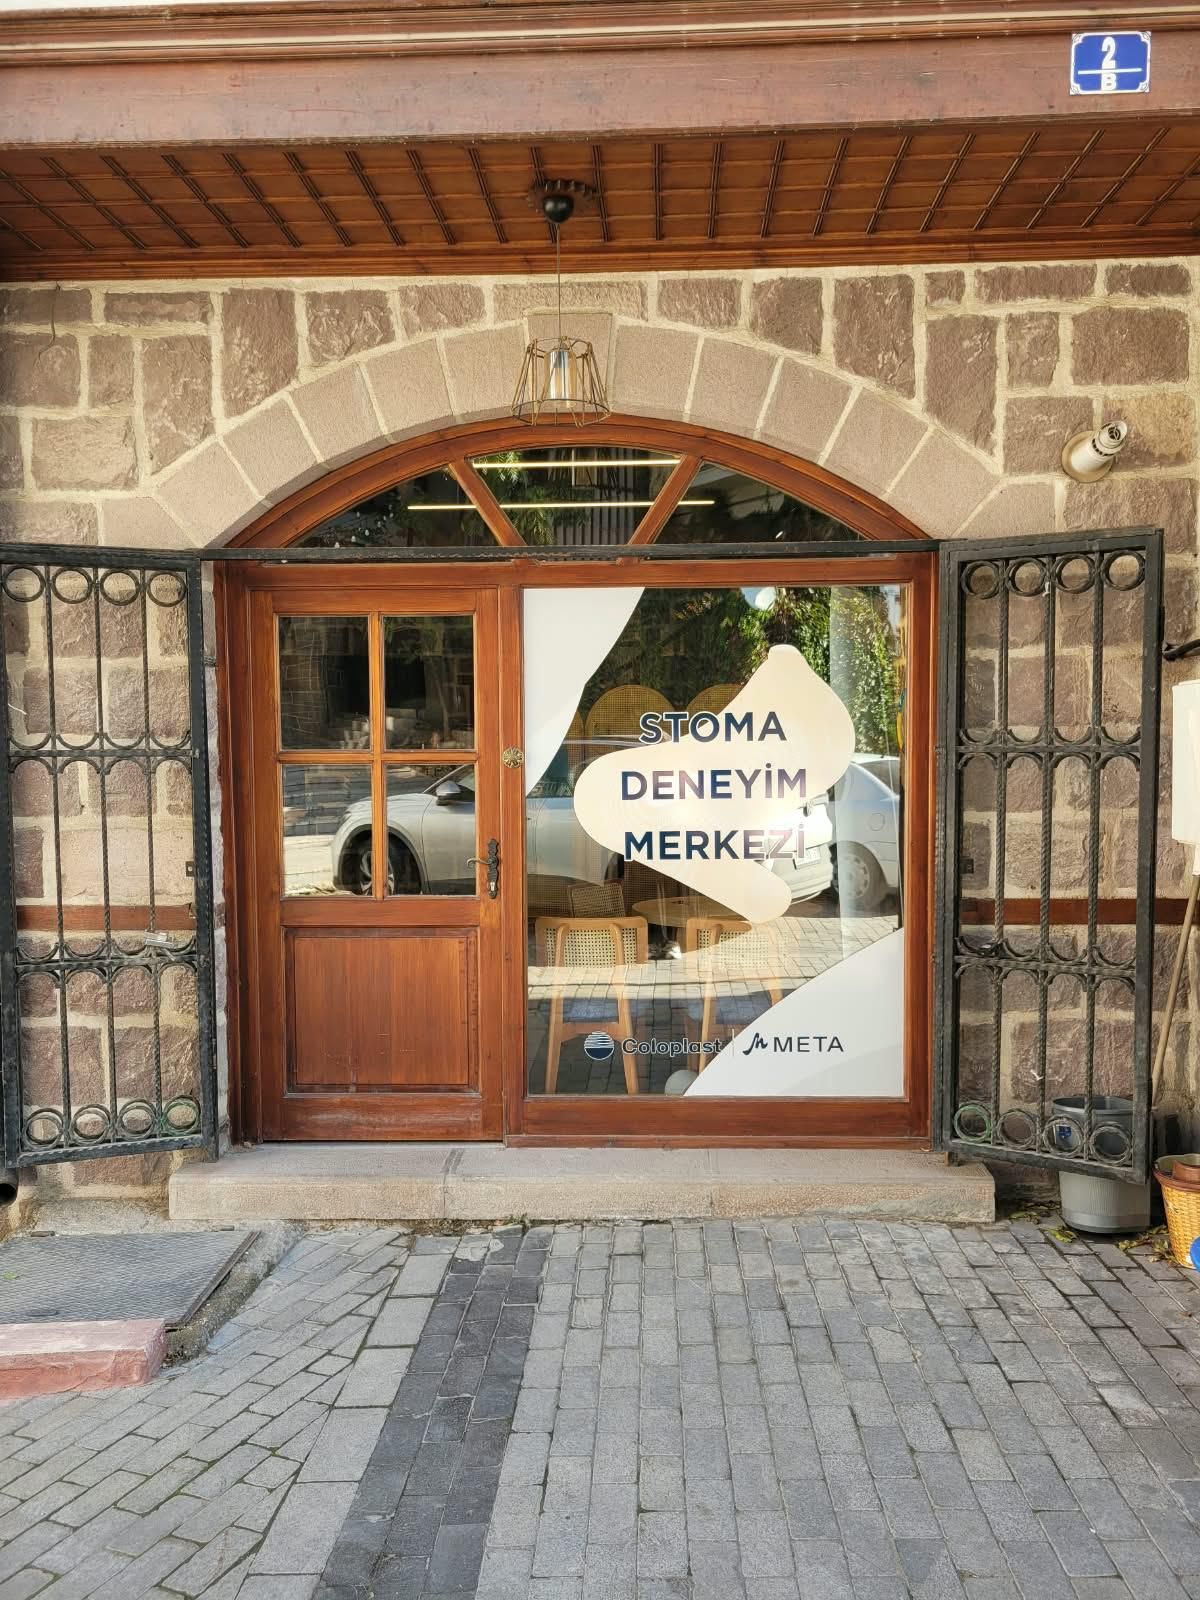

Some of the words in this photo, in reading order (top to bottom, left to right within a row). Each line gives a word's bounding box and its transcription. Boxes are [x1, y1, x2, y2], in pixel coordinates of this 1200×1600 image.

[1101, 36, 1116, 70] 2
[1101, 73, 1117, 91] B
[639, 711, 787, 744] STOMA
[621, 763, 807, 800] DENEYİM
[624, 823, 805, 861] MERKEZİ
[622, 1038, 722, 1057] Coloplast
[773, 1036, 844, 1053] META
